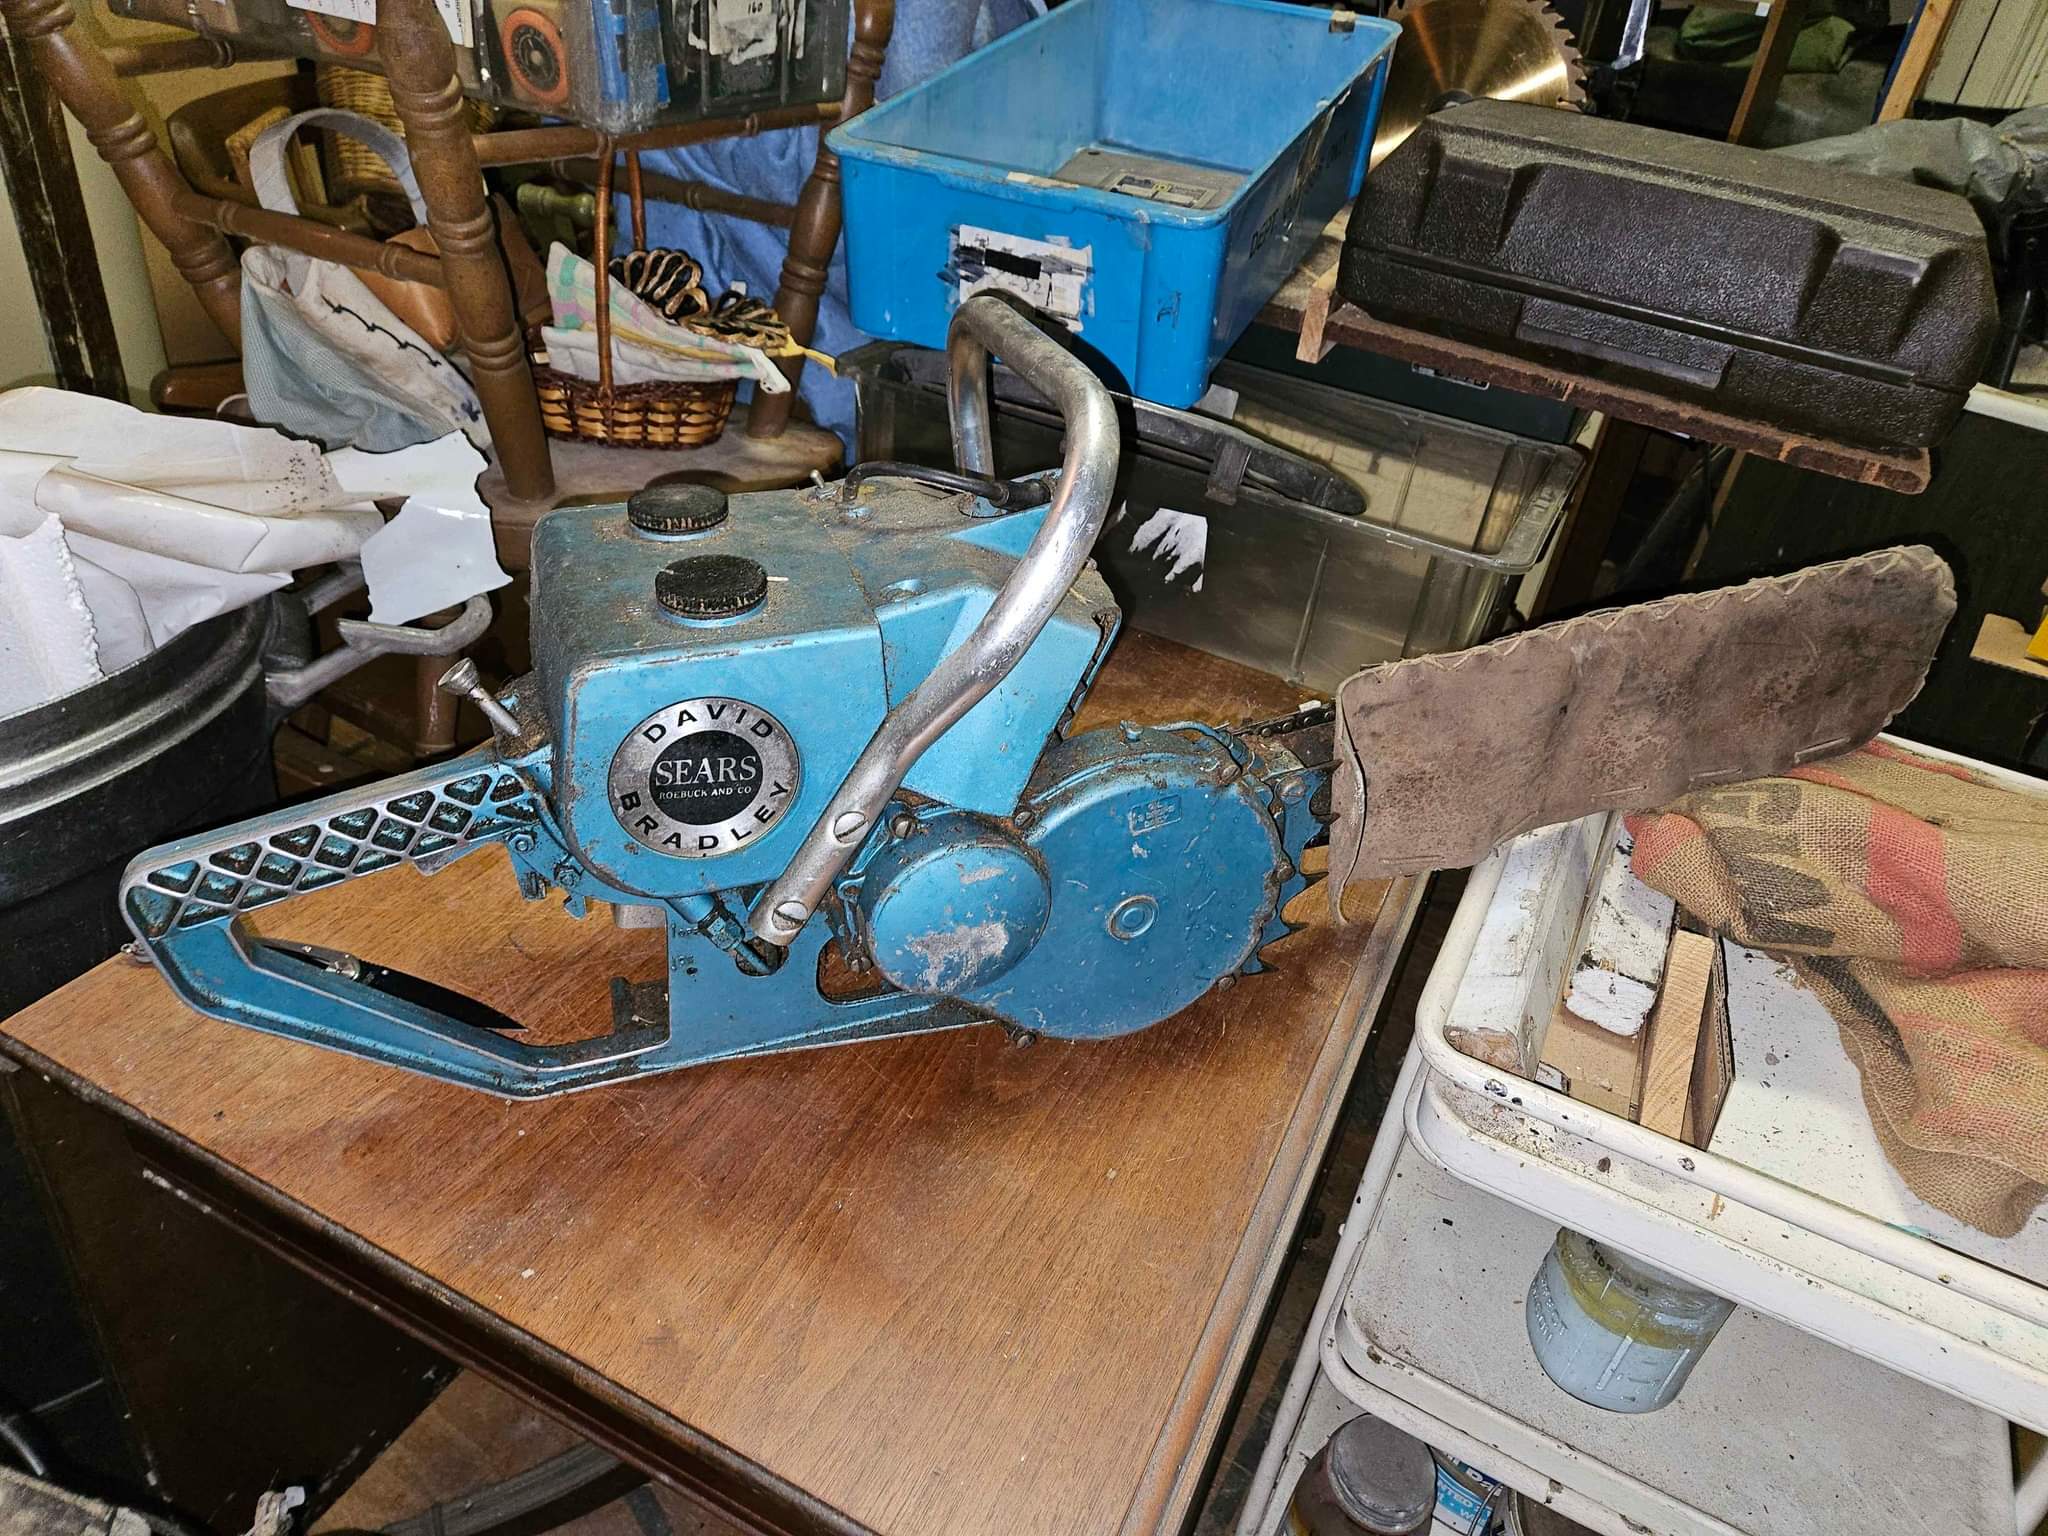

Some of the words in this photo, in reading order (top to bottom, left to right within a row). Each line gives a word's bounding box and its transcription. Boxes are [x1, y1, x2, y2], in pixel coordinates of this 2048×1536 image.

[642, 703, 774, 744] DAVID
[655, 756, 757, 786] SEARS
[659, 789, 708, 800] ROEBUCK
[711, 787, 733, 797] AND
[737, 785, 752, 794] CO
[620, 780, 790, 850] BRADLEY
